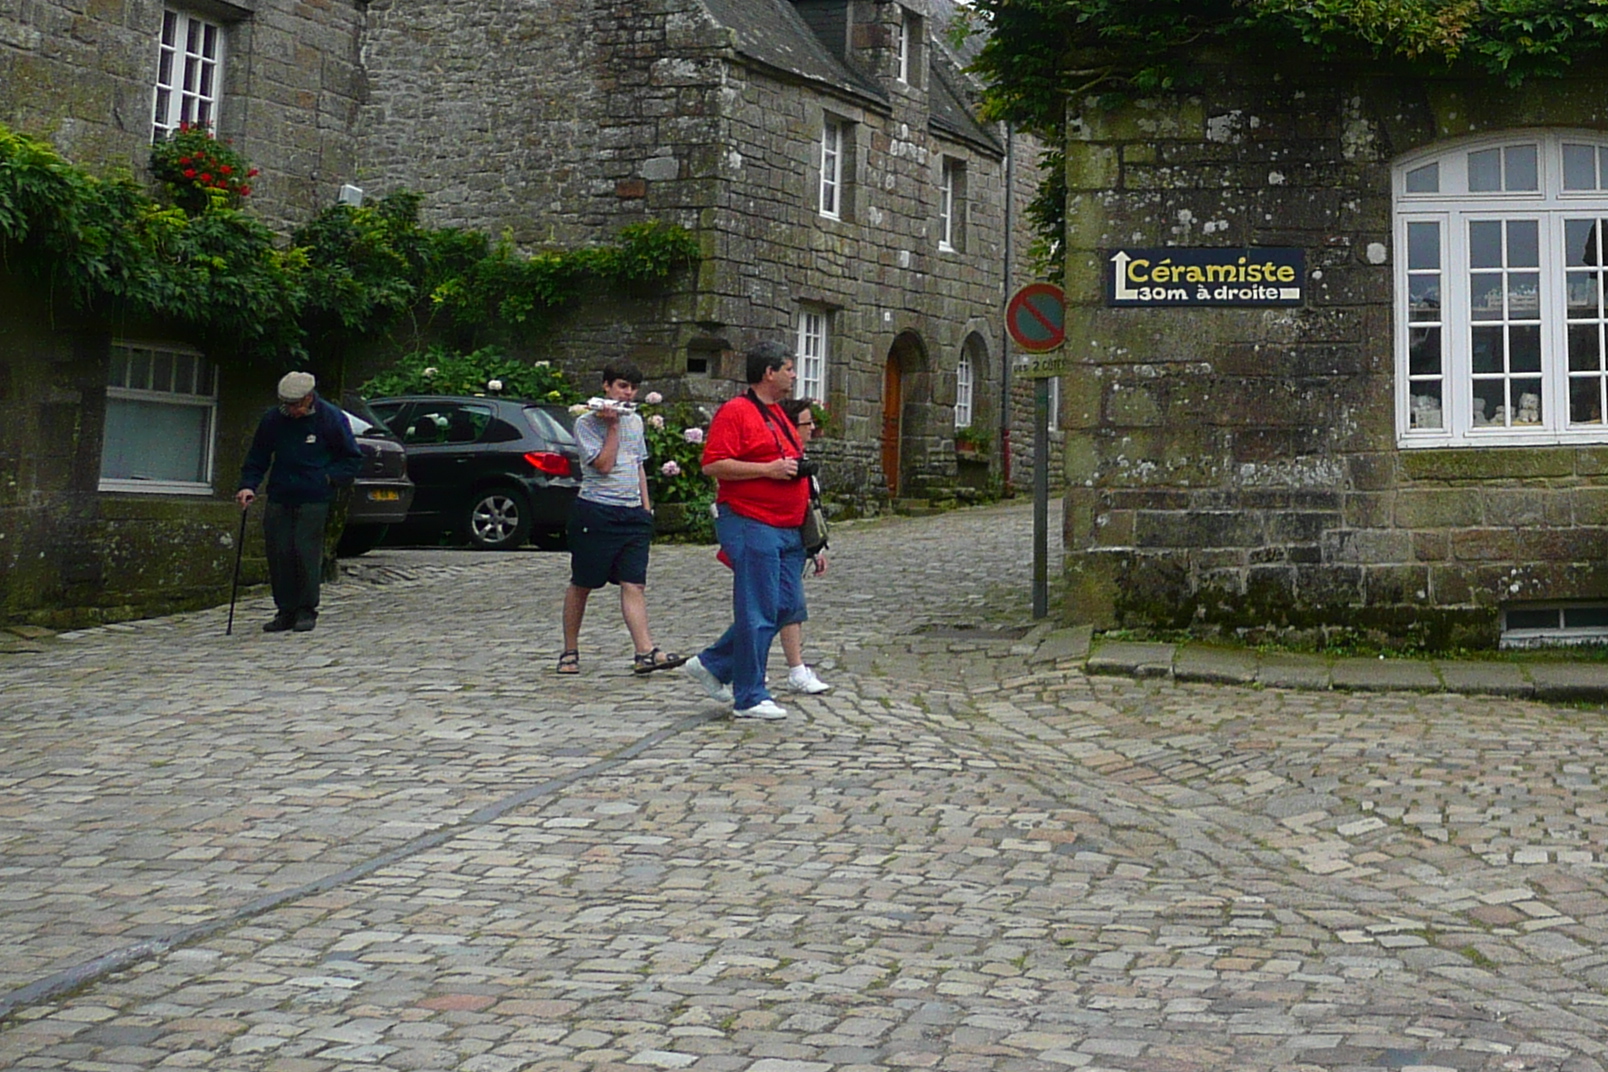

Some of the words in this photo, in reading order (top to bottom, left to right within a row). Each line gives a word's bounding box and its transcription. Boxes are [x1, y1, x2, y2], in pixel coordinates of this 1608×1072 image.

[1127, 257, 1296, 282] Céramiste
[1138, 286, 1189, 301] 30m
[1196, 283, 1211, 301] à
[1213, 284, 1280, 301] droite
[1032, 360, 1041, 372] 2
